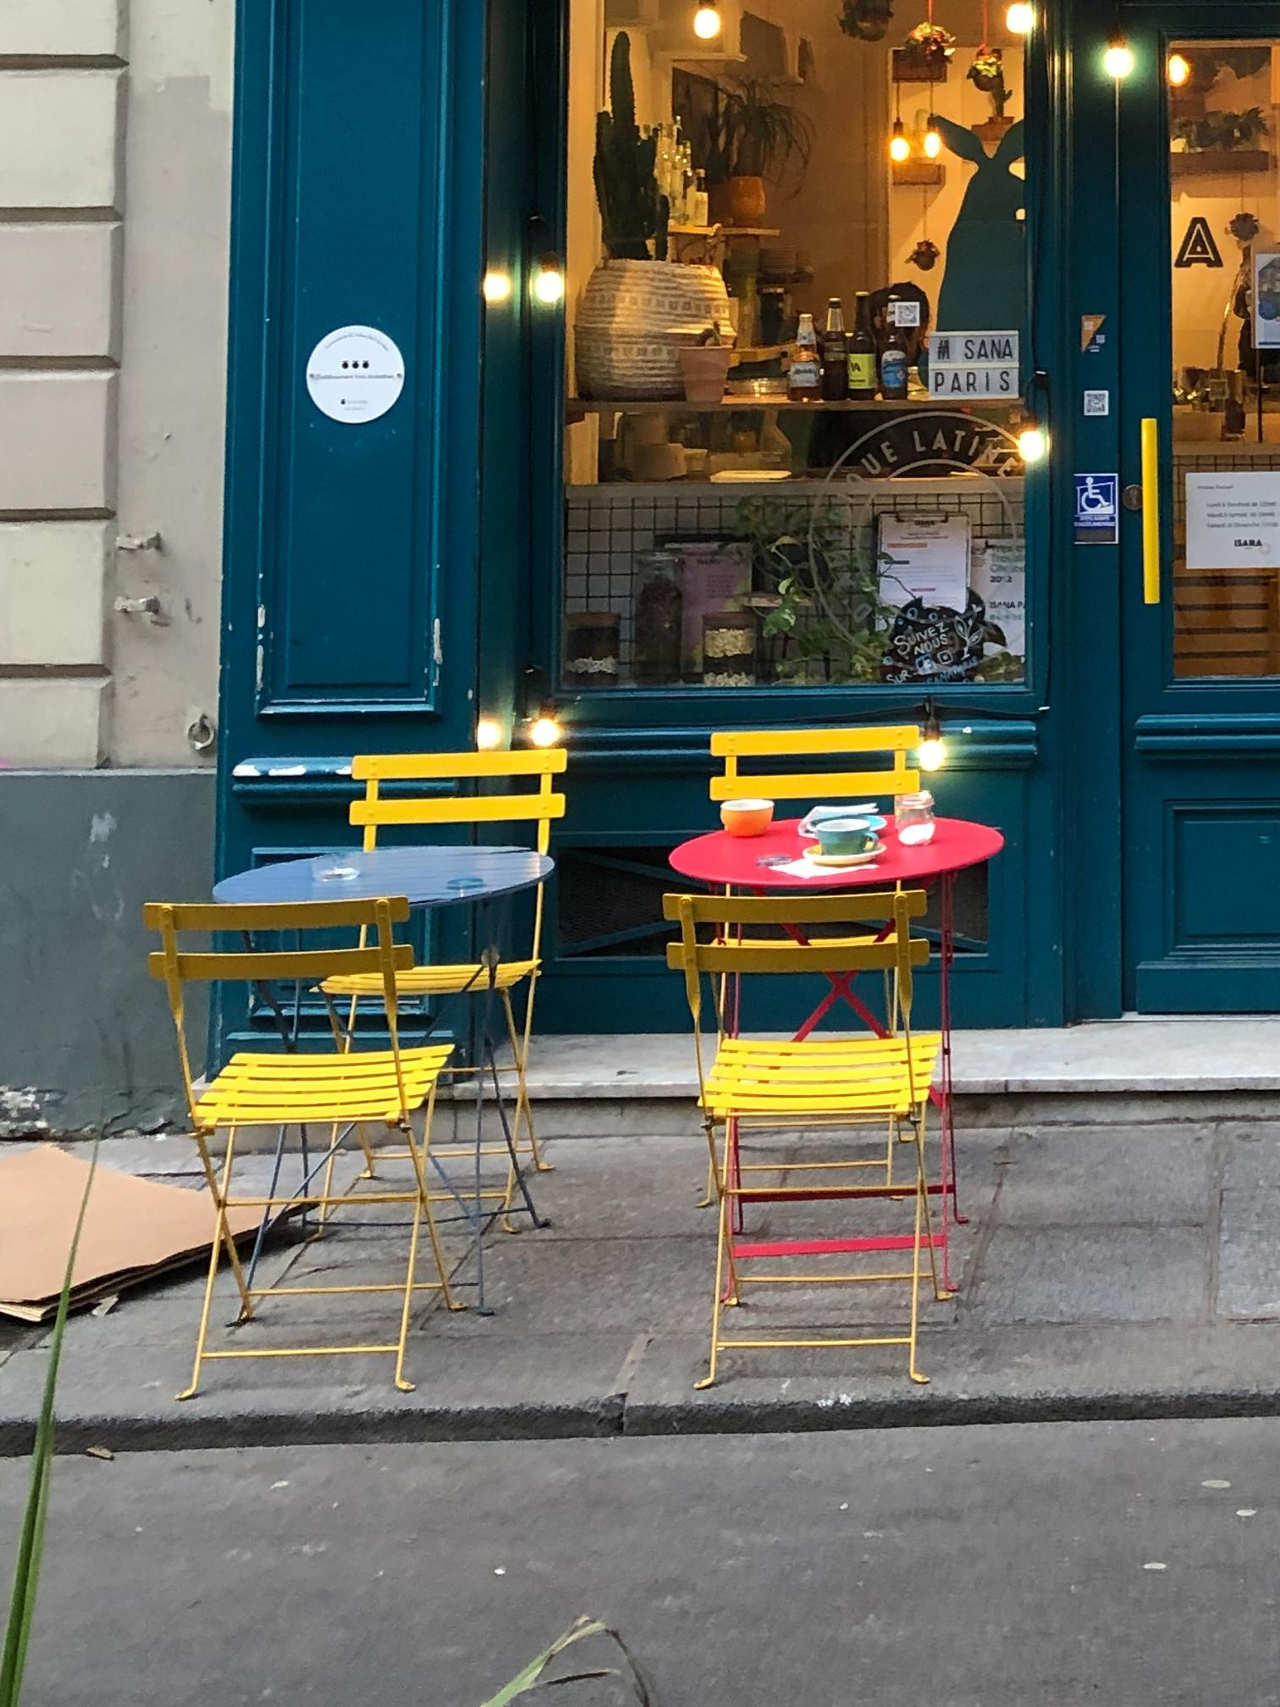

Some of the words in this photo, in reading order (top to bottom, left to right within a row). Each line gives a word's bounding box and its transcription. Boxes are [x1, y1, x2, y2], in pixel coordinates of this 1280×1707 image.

[1174, 216, 1224, 269] A
[934, 370, 1011, 393] PARIS
[893, 622, 949, 655] SUIVEZ
[914, 633, 949, 655] NOUS
[886, 670, 911, 684] SUR
